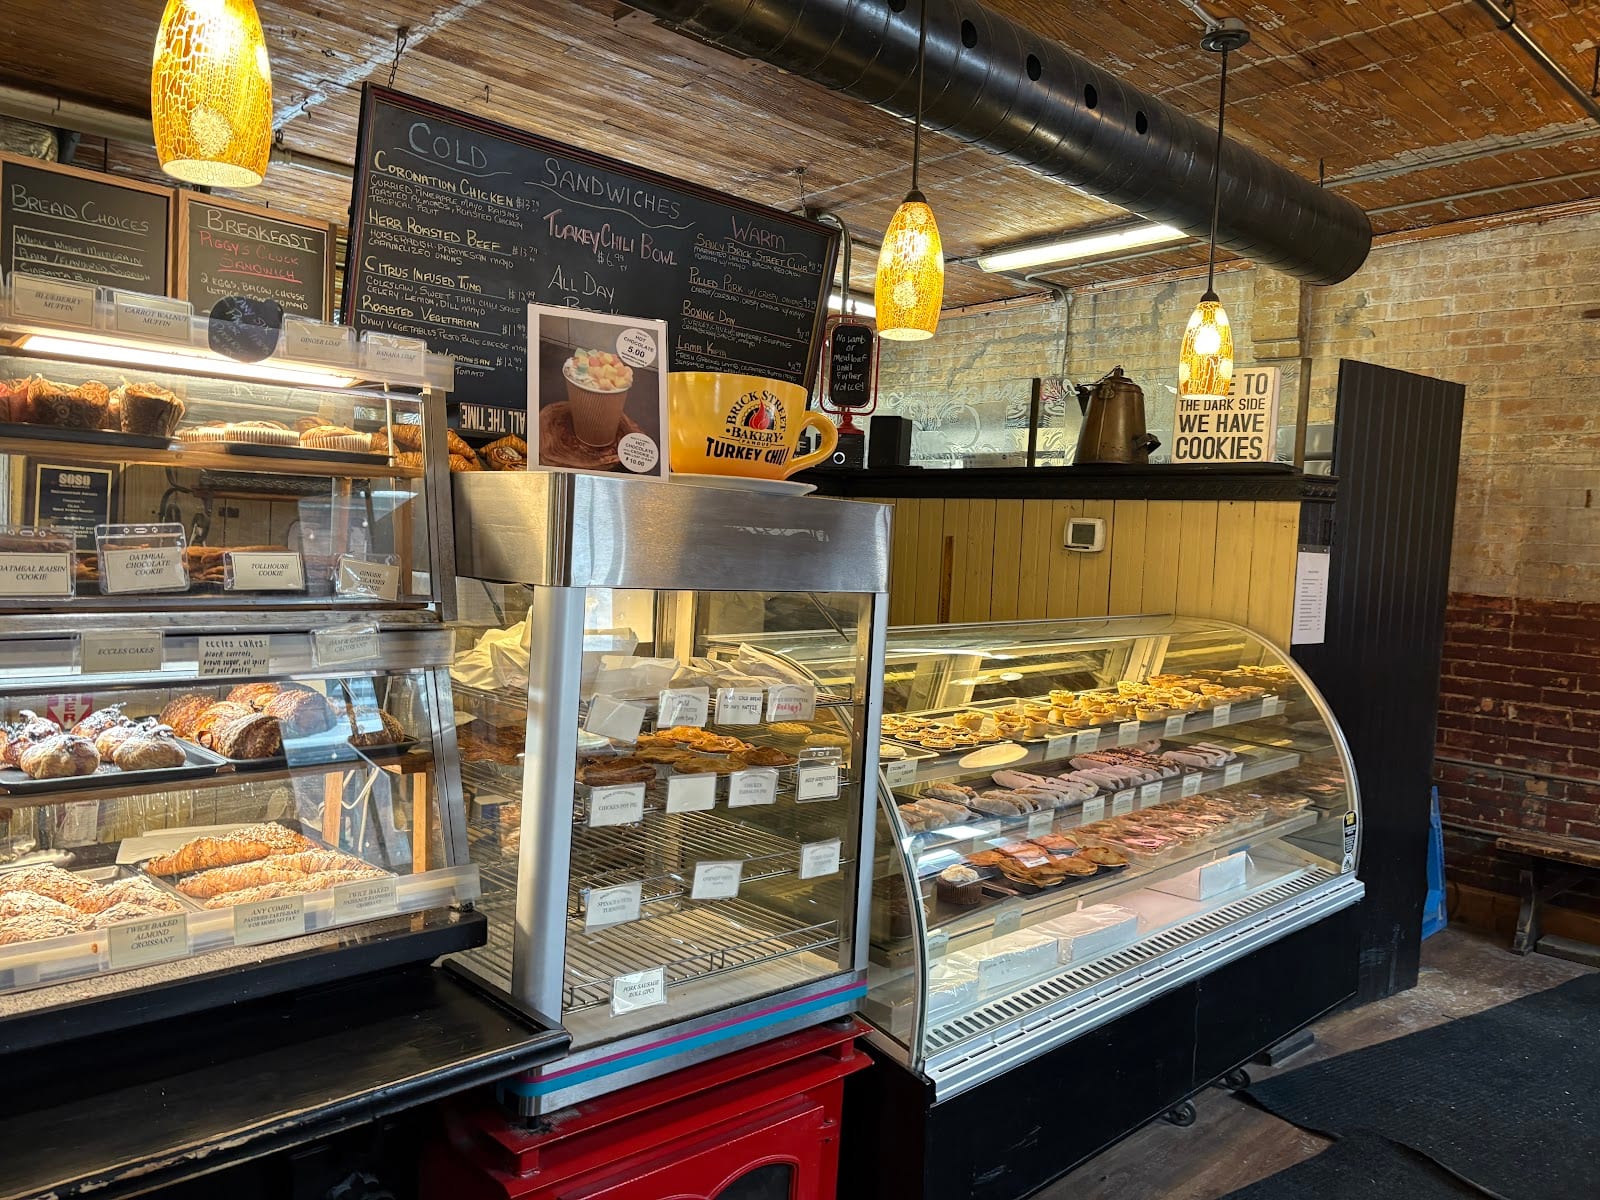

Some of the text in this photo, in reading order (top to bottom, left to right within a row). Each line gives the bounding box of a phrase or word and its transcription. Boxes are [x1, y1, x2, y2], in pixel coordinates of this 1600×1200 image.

[408, 122, 487, 169] COLD
[375, 151, 514, 207] CORONATION CHICKEN
[369, 186, 408, 201] TOASTED
[544, 157, 681, 220] SANDWICHES
[368, 194, 438, 216] TROPICAL FRUIT
[370, 175, 412, 195] CURRIED
[488, 205, 520, 221] RAISINS
[11, 184, 149, 232] BREAD CHOICES
[207, 209, 313, 250] BREAKFAST
[368, 208, 502, 251] HERB ROASTED BEEF
[543, 209, 678, 265] TURKEY CHILI BOWL
[732, 215, 785, 251] WARM
[19, 247, 48, 262] PLAIN
[368, 237, 463, 266] CARAMELIZED ONIONS
[727, 242, 752, 258] BRICK
[756, 250, 786, 267] STREET
[787, 258, 808, 273] CLUB
[220, 255, 294, 280] SANDWICH
[490, 256, 514, 270] MAYO
[365, 255, 482, 293] CITRUS INFUSED TUNA
[690, 267, 718, 288] PULLED
[723, 274, 743, 293] PORK
[201, 272, 208, 283] 2
[275, 289, 305, 301] CHEESE
[548, 265, 615, 304] ALL DAY
[34, 291, 81, 305] BLUEBERRY
[419, 286, 450, 299] SWEET
[455, 295, 476, 304] THAI
[43, 301, 73, 312] MUFFIN
[124, 306, 189, 323] CARROT WALNUT
[362, 295, 480, 328] ROASTED VEGETARIAN
[440, 301, 460, 311] DILL
[461, 305, 485, 316] MAYO
[682, 300, 736, 325] BOXING DAY
[142, 317, 171, 327] MUFFIN
[624, 336, 654, 352] CHOCOLATE
[677, 335, 702, 353] LAMB
[836, 334, 865, 344] No Lamb
[627, 346, 645, 358] 5.00
[1244, 373, 1269, 395] TO
[726, 390, 787, 432] BRICK STREET
[1180, 398, 1265, 411] THE DARK SIDE
[461, 405, 526, 434] ALL THE TIME
[1179, 413, 1265, 433] WE HAVE
[731, 427, 781, 443] BAKERY
[625, 443, 654, 454] CHOCOLATE
[706, 437, 762, 461] TURKEY
[1175, 436, 1263, 460] COOKIES
[125, 560, 171, 569] CHOCOLATE
[129, 552, 166, 560] OATMEAL
[15, 573, 48, 581] COOKIE
[38, 565, 66, 573] RAISIN
[134, 568, 164, 576] COOKIE
[97, 647, 155, 656] ECCLES CAKES
[206, 640, 234, 648] eccles
[231, 666, 252, 674] pastry
[252, 659, 266, 667] spice
[267, 904, 293, 913] COMBO
[126, 919, 178, 934] TWICE BAKED
[134, 928, 169, 941] ALMOND
[131, 936, 175, 950] CROISSANT
[637, 980, 660, 990] SAUSAGE
